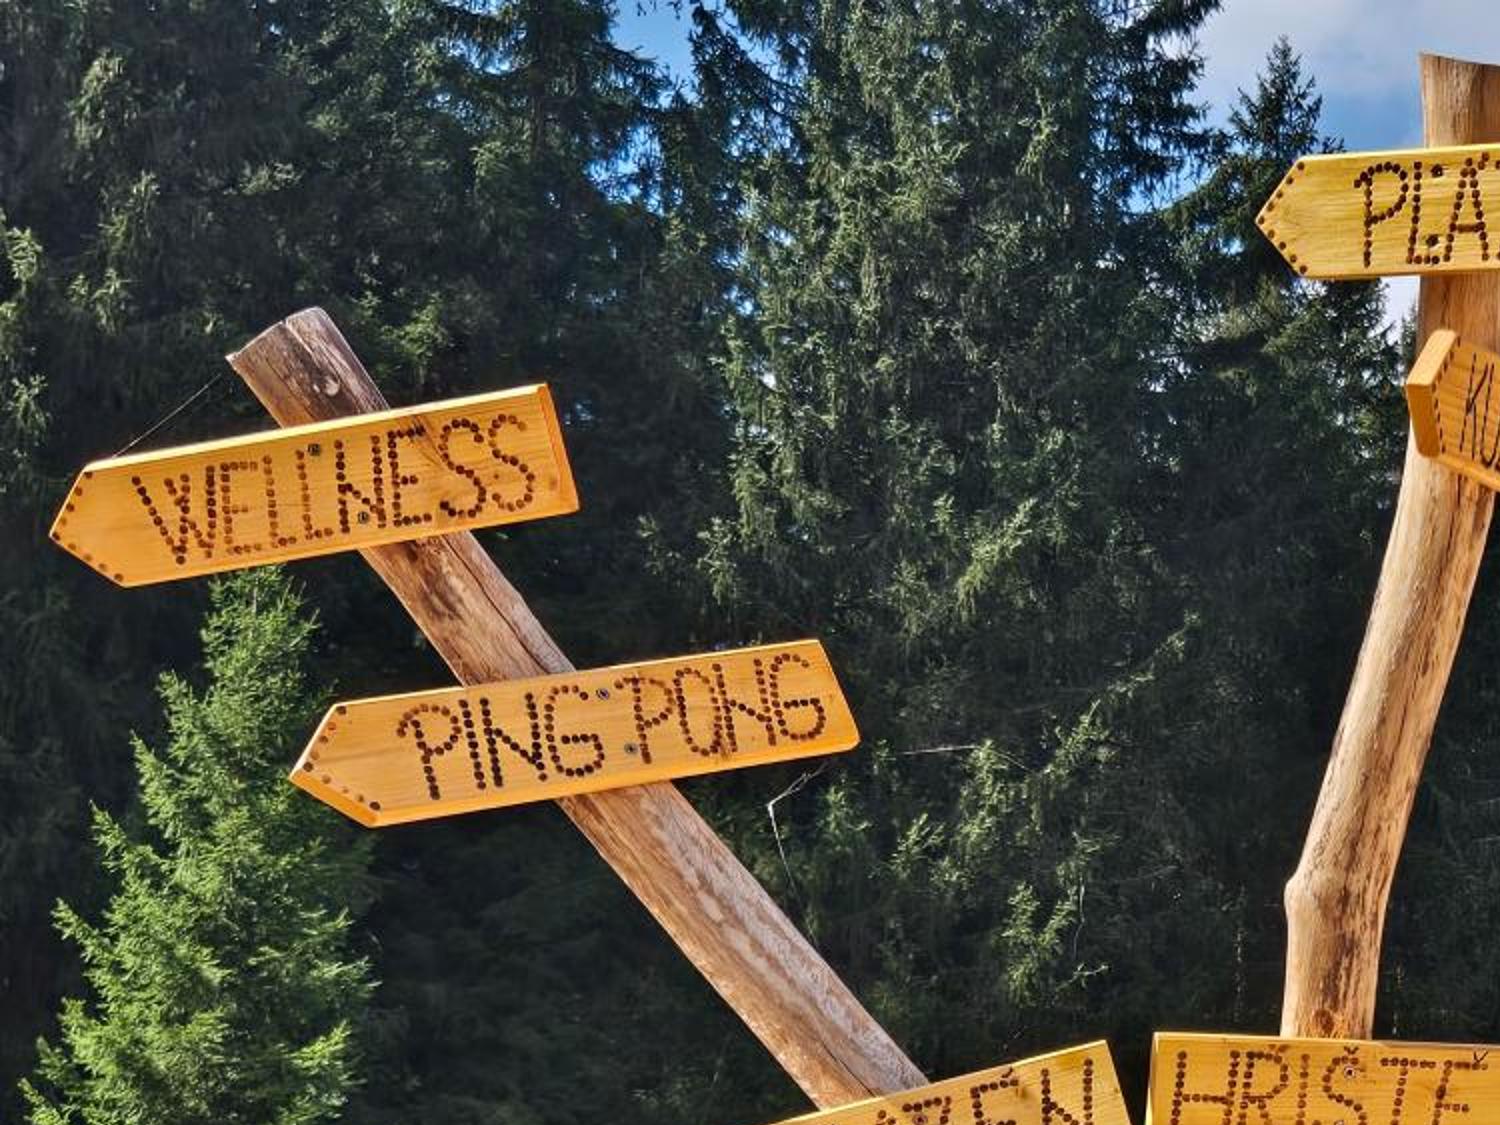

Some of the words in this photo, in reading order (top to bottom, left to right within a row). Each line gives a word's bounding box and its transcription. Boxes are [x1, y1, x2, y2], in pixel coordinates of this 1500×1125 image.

[132, 413, 535, 565] WELLNESS
[396, 684, 604, 800] PING
[614, 653, 826, 764] PONG
